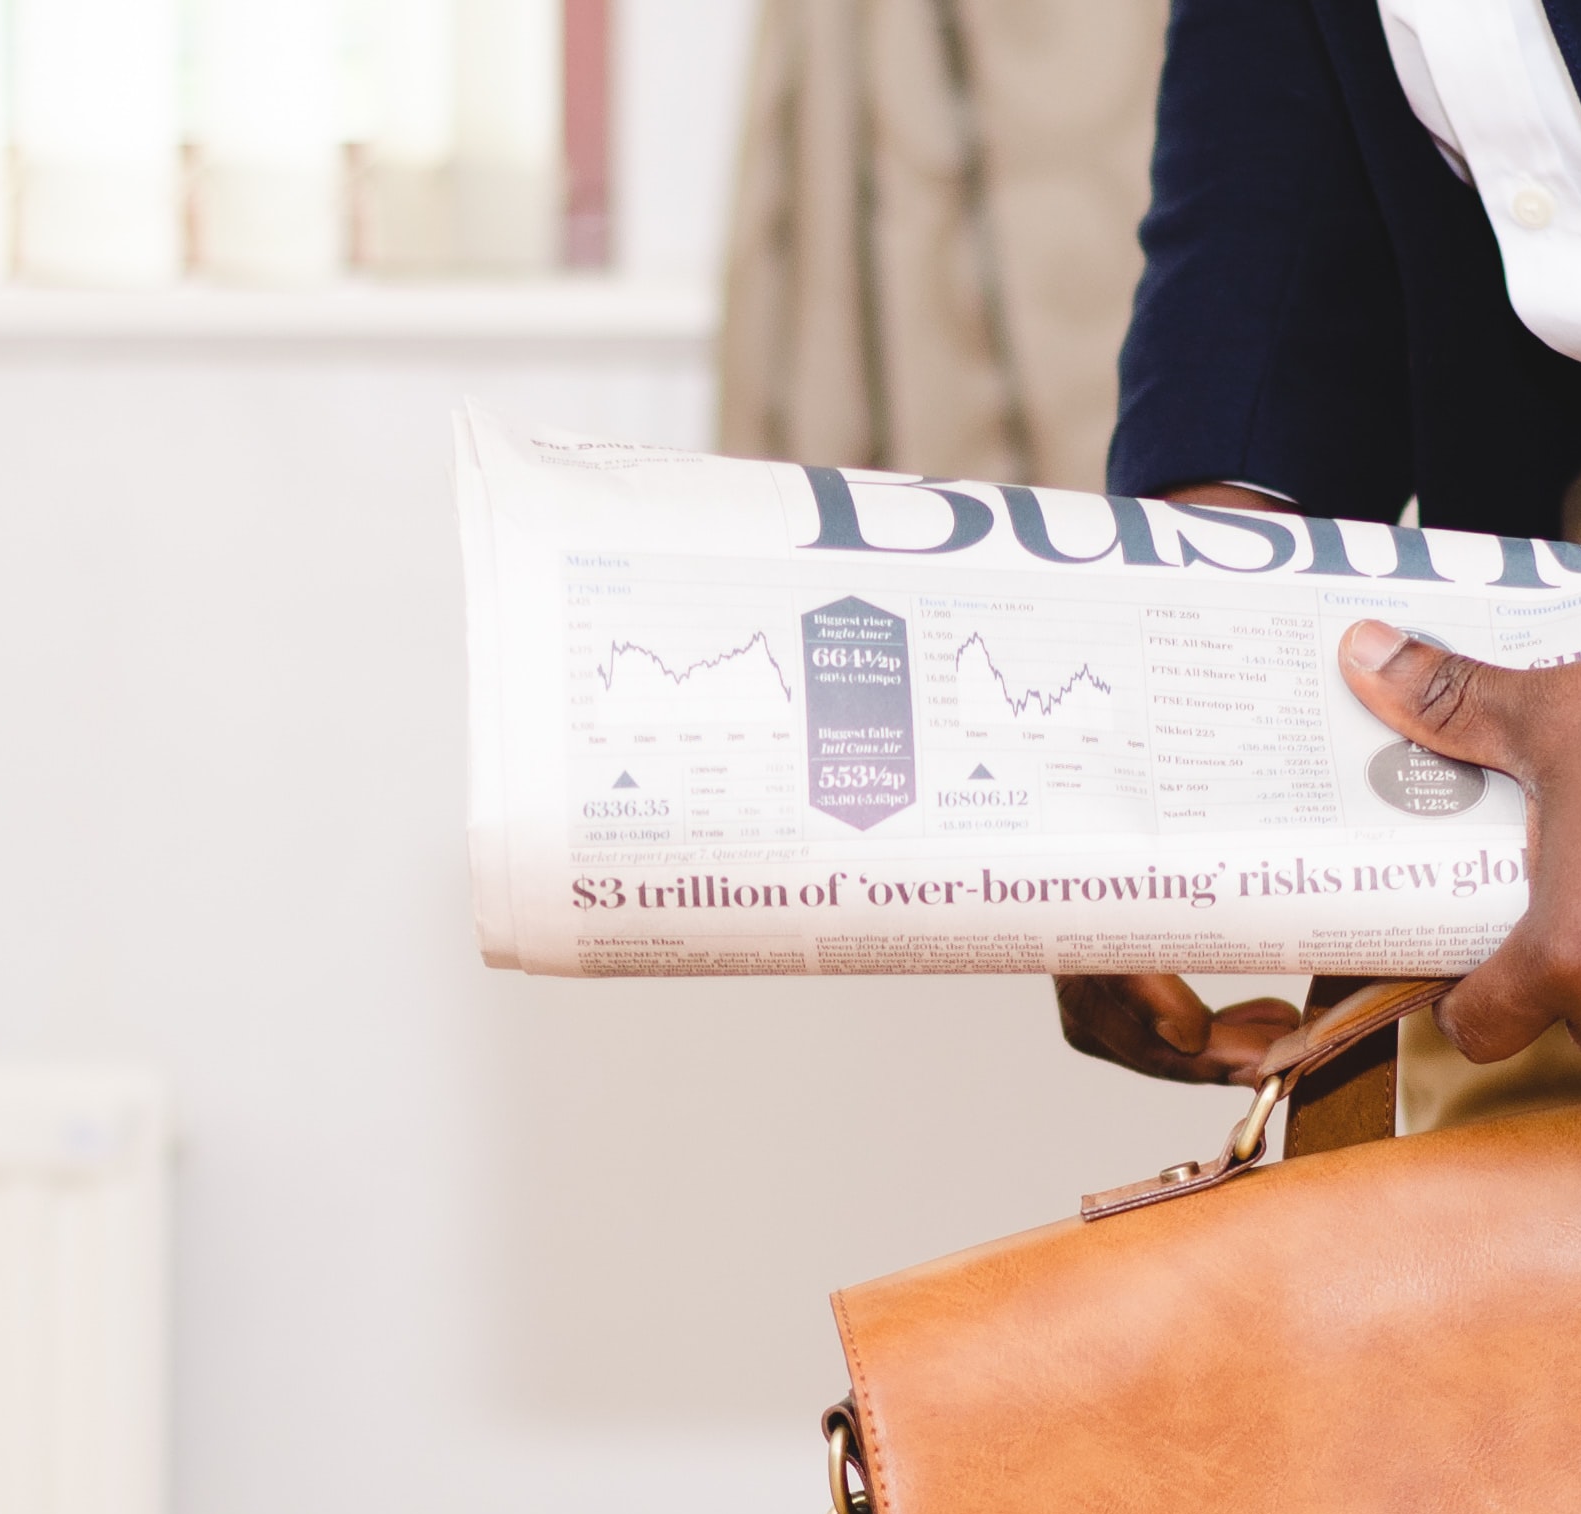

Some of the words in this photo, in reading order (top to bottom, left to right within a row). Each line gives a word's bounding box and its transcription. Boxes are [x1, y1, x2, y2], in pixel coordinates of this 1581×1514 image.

[566, 555, 630, 568] Markets
[1324, 592, 1409, 609] Currencies
[814, 614, 860, 627] Biggest
[863, 616, 894, 628] riser
[1146, 608, 1177, 619] FTSE
[1179, 611, 1201, 621] 250
[818, 627, 856, 640] Anglo
[856, 629, 893, 640] Amer
[1500, 631, 1531, 643] Gold
[1149, 636, 1179, 647] FTSE
[1182, 639, 1198, 648] All
[1200, 640, 1234, 651] Share
[1151, 665, 1181, 677] FTSE
[1184, 667, 1200, 678] All
[1202, 669, 1236, 680] Share
[1238, 671, 1267, 683] Yield
[1153, 694, 1183, 706] FTSE
[1185, 697, 1233, 712] Eurotop
[1235, 701, 1255, 712] 100
[818, 727, 866, 741] Biggest
[868, 727, 904, 739] faller
[1155, 724, 1193, 736] Nikkei
[1195, 728, 1216, 738] 225
[821, 742, 845, 755] Intl
[846, 743, 879, 754] Cons
[880, 742, 904, 754] Air
[1158, 753, 1172, 764] DJ
[1228, 759, 1244, 767] 50
[1409, 758, 1439, 768] Rate
[1396, 769, 1458, 783] 1.3628
[1159, 783, 1184, 792] S&P
[1186, 783, 1210, 792] 500
[1405, 786, 1454, 797] Change
[937, 789, 1030, 808] 16806.12
[582, 798, 670, 819] 6336.35
[1163, 807, 1207, 819] Nasdaq
[570, 850, 619, 863] Market
[620, 851, 662, 864] report
[662, 851, 697, 865] page
[712, 847, 763, 861] Questor
[765, 847, 797, 862] page
[571, 873, 626, 912] $3
[636, 874, 789, 909] trillion
[799, 872, 850, 909] of
[1238, 861, 1342, 897] risks
[1352, 866, 1440, 892] new
[1451, 847, 1528, 897] glo
[1056, 932, 1095, 943] gating
[1096, 932, 1128, 941] these
[1130, 931, 1192, 941] hazardous
[1312, 928, 1348, 938] Seven
[1350, 929, 1383, 939] years
[1385, 926, 1413, 937] after
[1415, 924, 1436, 936] the
[1437, 922, 1490, 935] financial
[594, 938, 649, 946] Mehreen
[651, 938, 685, 946] Khan
[815, 934, 889, 943] quadrupling
[893, 934, 906, 942] of
[908, 934, 950, 944] private
[953, 934, 990, 942] sector
[993, 933, 1020, 942] debt
[1298, 939, 1354, 950] lingering
[1354, 938, 1382, 948] debt
[1383, 937, 1434, 948] burdens
[1435, 937, 1447, 947] in
[1448, 936, 1469, 946] the
[856, 943, 886, 951] 2004
[889, 943, 911, 951] and
[946, 943, 965, 951] the
[1004, 943, 1044, 951] Global
[1071, 942, 1095, 950] The
[1102, 942, 1152, 951] slightest
[1258, 940, 1285, 951] they
[1298, 949, 1363, 958] economies
[1365, 948, 1388, 958] and
[1399, 947, 1425, 958] lack
[1427, 946, 1441, 957] of
[1442, 946, 1486, 957] market
[876, 951, 925, 959] Stability
[930, 951, 971, 959] Report
[1317, 957, 1351, 966] could
[1354, 957, 1389, 966] result
[1417, 958, 1444, 966] new
[1446, 956, 1482, 967] credit
